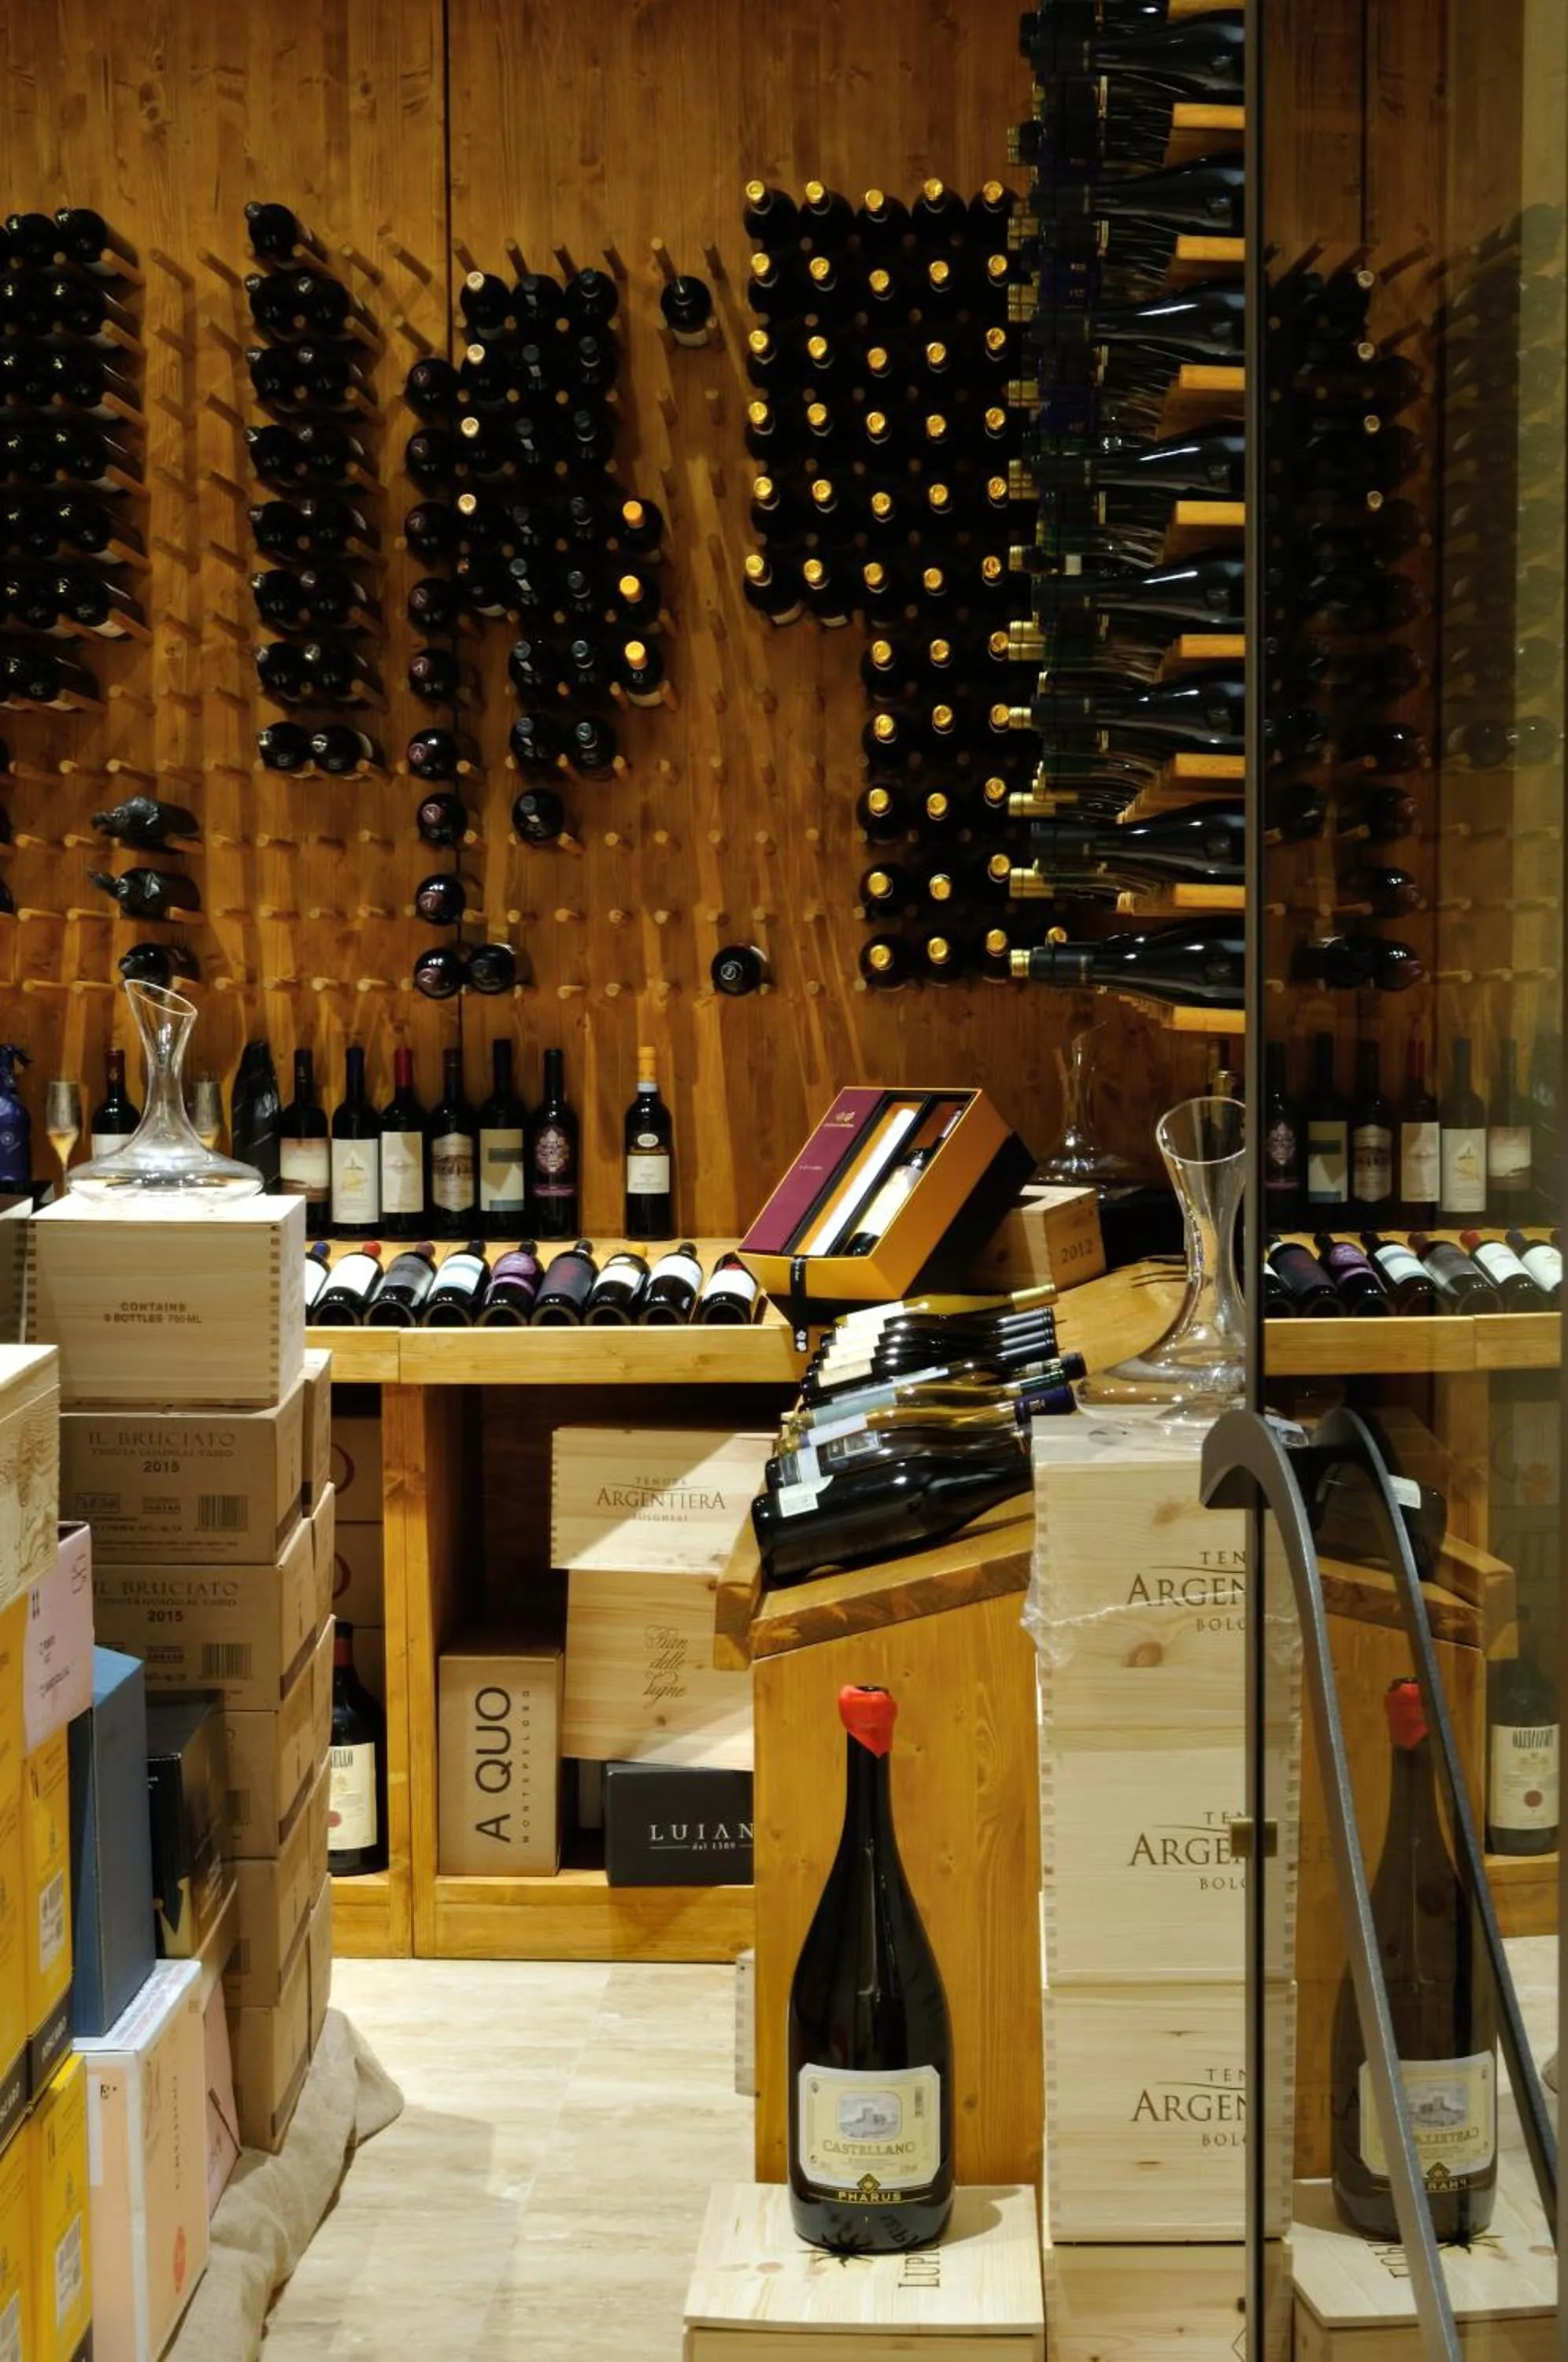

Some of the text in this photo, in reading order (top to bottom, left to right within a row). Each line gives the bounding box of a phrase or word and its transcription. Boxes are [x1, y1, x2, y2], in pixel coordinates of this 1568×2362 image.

[120, 1301, 186, 1312] CONTAINS
[113, 1313, 163, 1323] BOTTLES
[89, 1431, 235, 1447] IL BRUCIATO
[142, 1461, 179, 1472] 2015
[597, 1486, 725, 1509] ARGENTIERA
[123, 1581, 239, 1596] BRUCIATO
[147, 1610, 183, 1622] 2015
[475, 1686, 512, 1843] A QUO
[649, 1823, 754, 1840] LUIAN
[1127, 1833, 1236, 1866] ARGE
[823, 2140, 916, 2156] CASTELLANO
[838, 2191, 902, 2202] PHARUS
